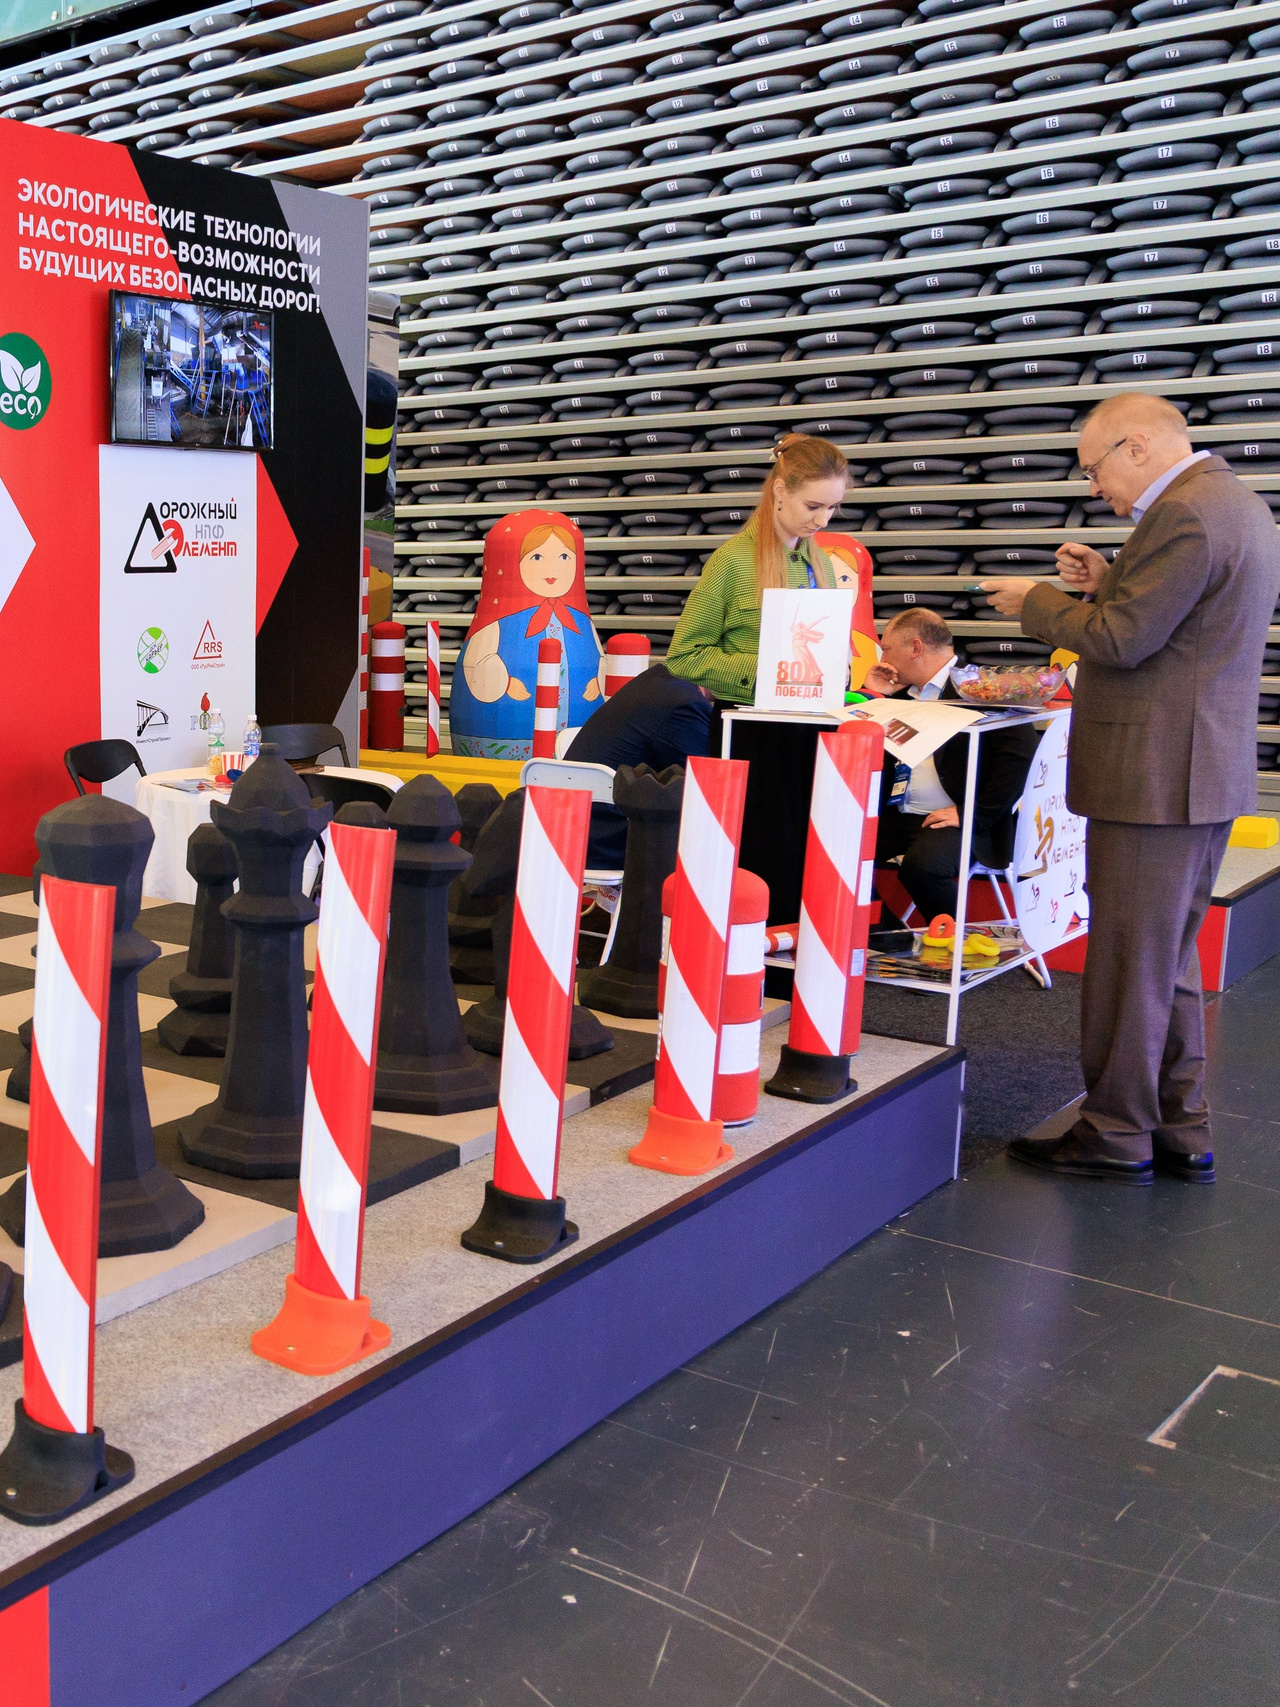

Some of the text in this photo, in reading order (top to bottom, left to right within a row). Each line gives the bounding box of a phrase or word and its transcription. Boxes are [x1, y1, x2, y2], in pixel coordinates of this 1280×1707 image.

[674, 12, 682, 20] 12
[851, 15, 861, 24] 14
[1055, 17, 1065, 26] 16
[759, 36, 768, 44] 13
[758, 81, 767, 90] 13
[1162, 97, 1173, 107] 17
[1047, 118, 1058, 128] 16
[1160, 147, 1170, 157] 17
[840, 154, 849, 162] 14
[752, 168, 761, 177] 13
[1042, 168, 1053, 178] 16
[939, 182, 949, 191] 15
[1155, 200, 1165, 209] 17
[17, 178, 321, 256] ЭКОЛОГИЧЕСКИЕ ТЕХНОЛОГИИ
[752, 211, 760, 219] 13
[1038, 213, 1048, 223] 16
[667, 224, 675, 232] 12
[933, 228, 942, 238] 15
[835, 242, 844, 251] 14
[1268, 240, 1280, 248] 18
[18, 213, 321, 285] НАСТОЯЩЕГО-ВОЗМОЖНОСТИ
[1146, 253, 1156, 261] 17
[1031, 265, 1041, 273] 16
[18, 247, 321, 313] БУДУЩИХ БЕЗОПАСНЫХ ДОРОГ!
[1264, 292, 1275, 302] 18
[827, 334, 836, 342] 14
[1259, 344, 1270, 354] 18
[1134, 354, 1145, 364] 17
[1026, 364, 1036, 372] 16
[826, 379, 836, 388] 14
[0, 392, 42, 420] eco
[1246, 446, 1257, 454] 18
[905, 594, 914, 602] 15
[204, 642, 222, 653] RRS
[776, 660, 803, 682] 80
[775, 686, 822, 699] ПОБЕДА!
